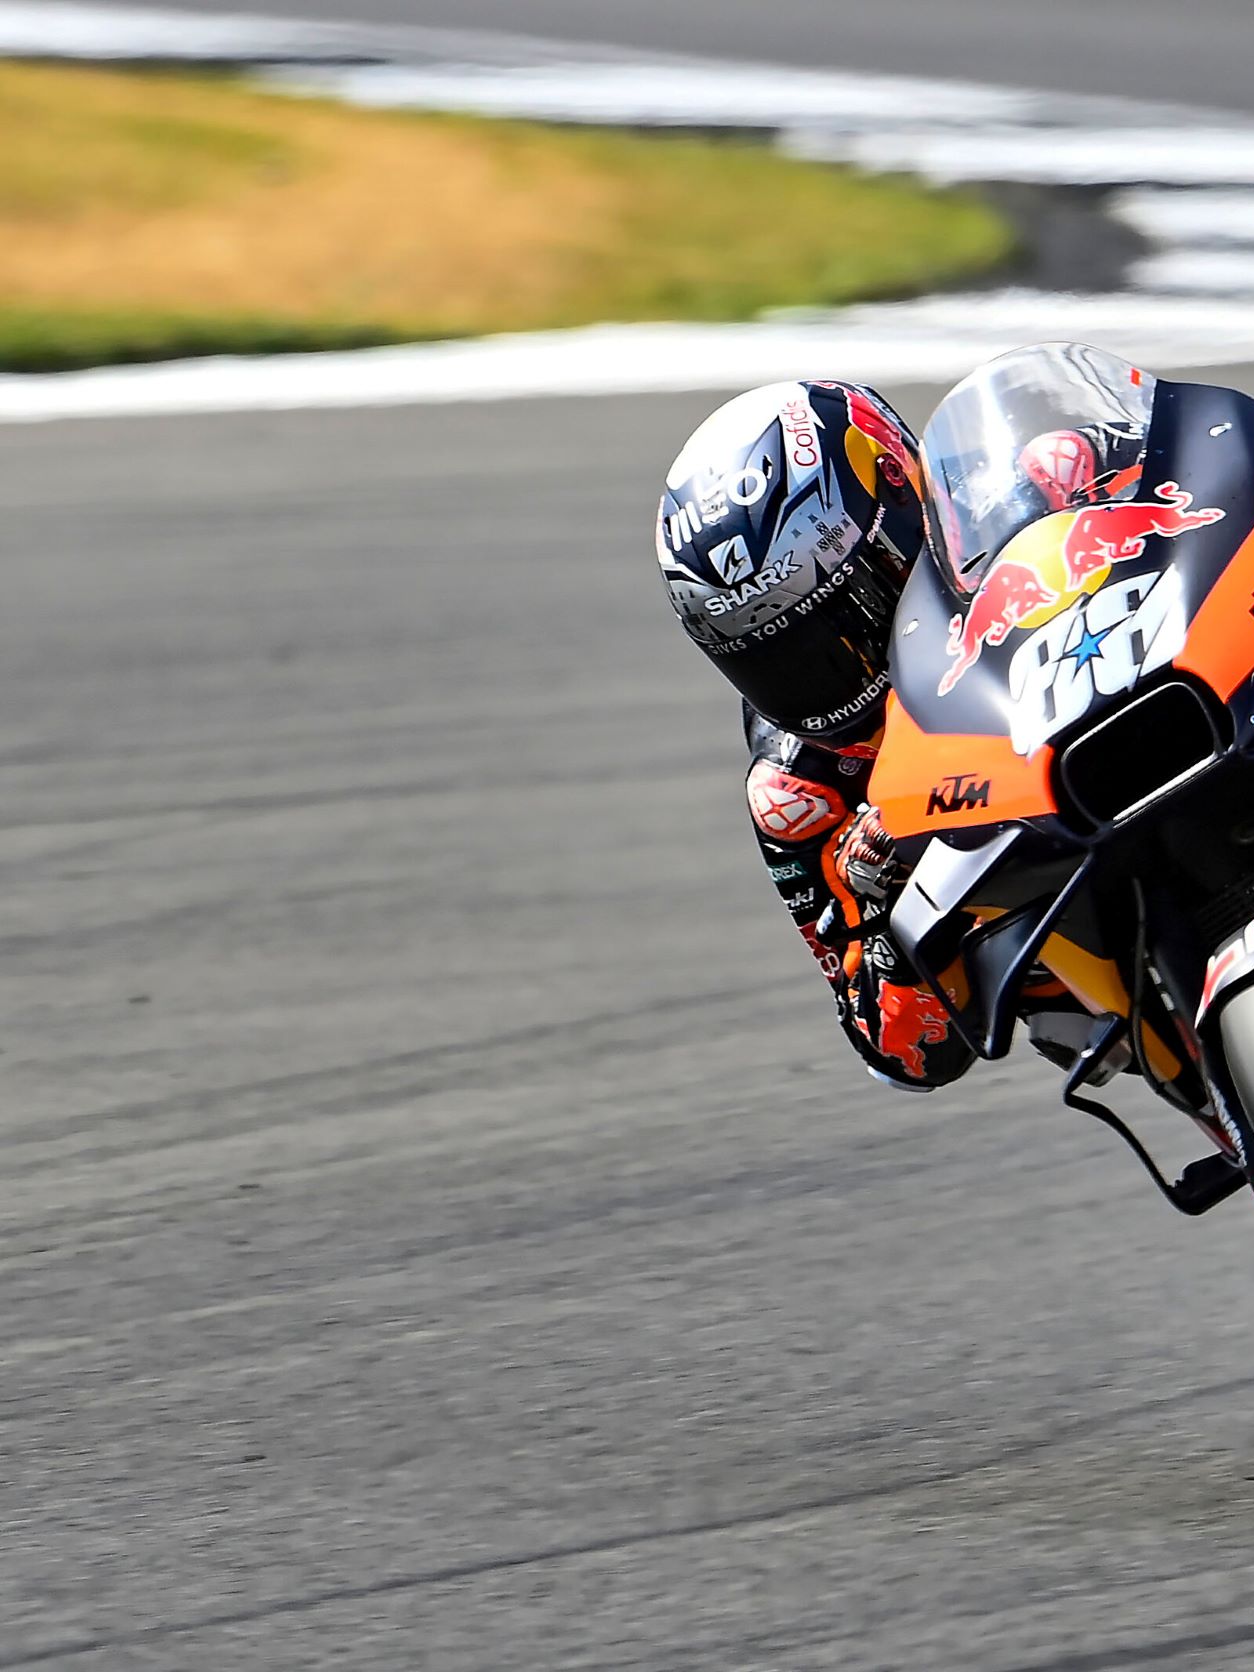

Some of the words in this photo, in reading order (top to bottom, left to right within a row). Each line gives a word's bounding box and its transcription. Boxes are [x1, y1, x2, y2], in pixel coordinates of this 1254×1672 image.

[704, 551, 804, 617] SHARK
[751, 614, 790, 642] YOU
[794, 562, 856, 616] WINGS
[1008, 563, 1190, 756] 88
[925, 773, 992, 817] KTM
